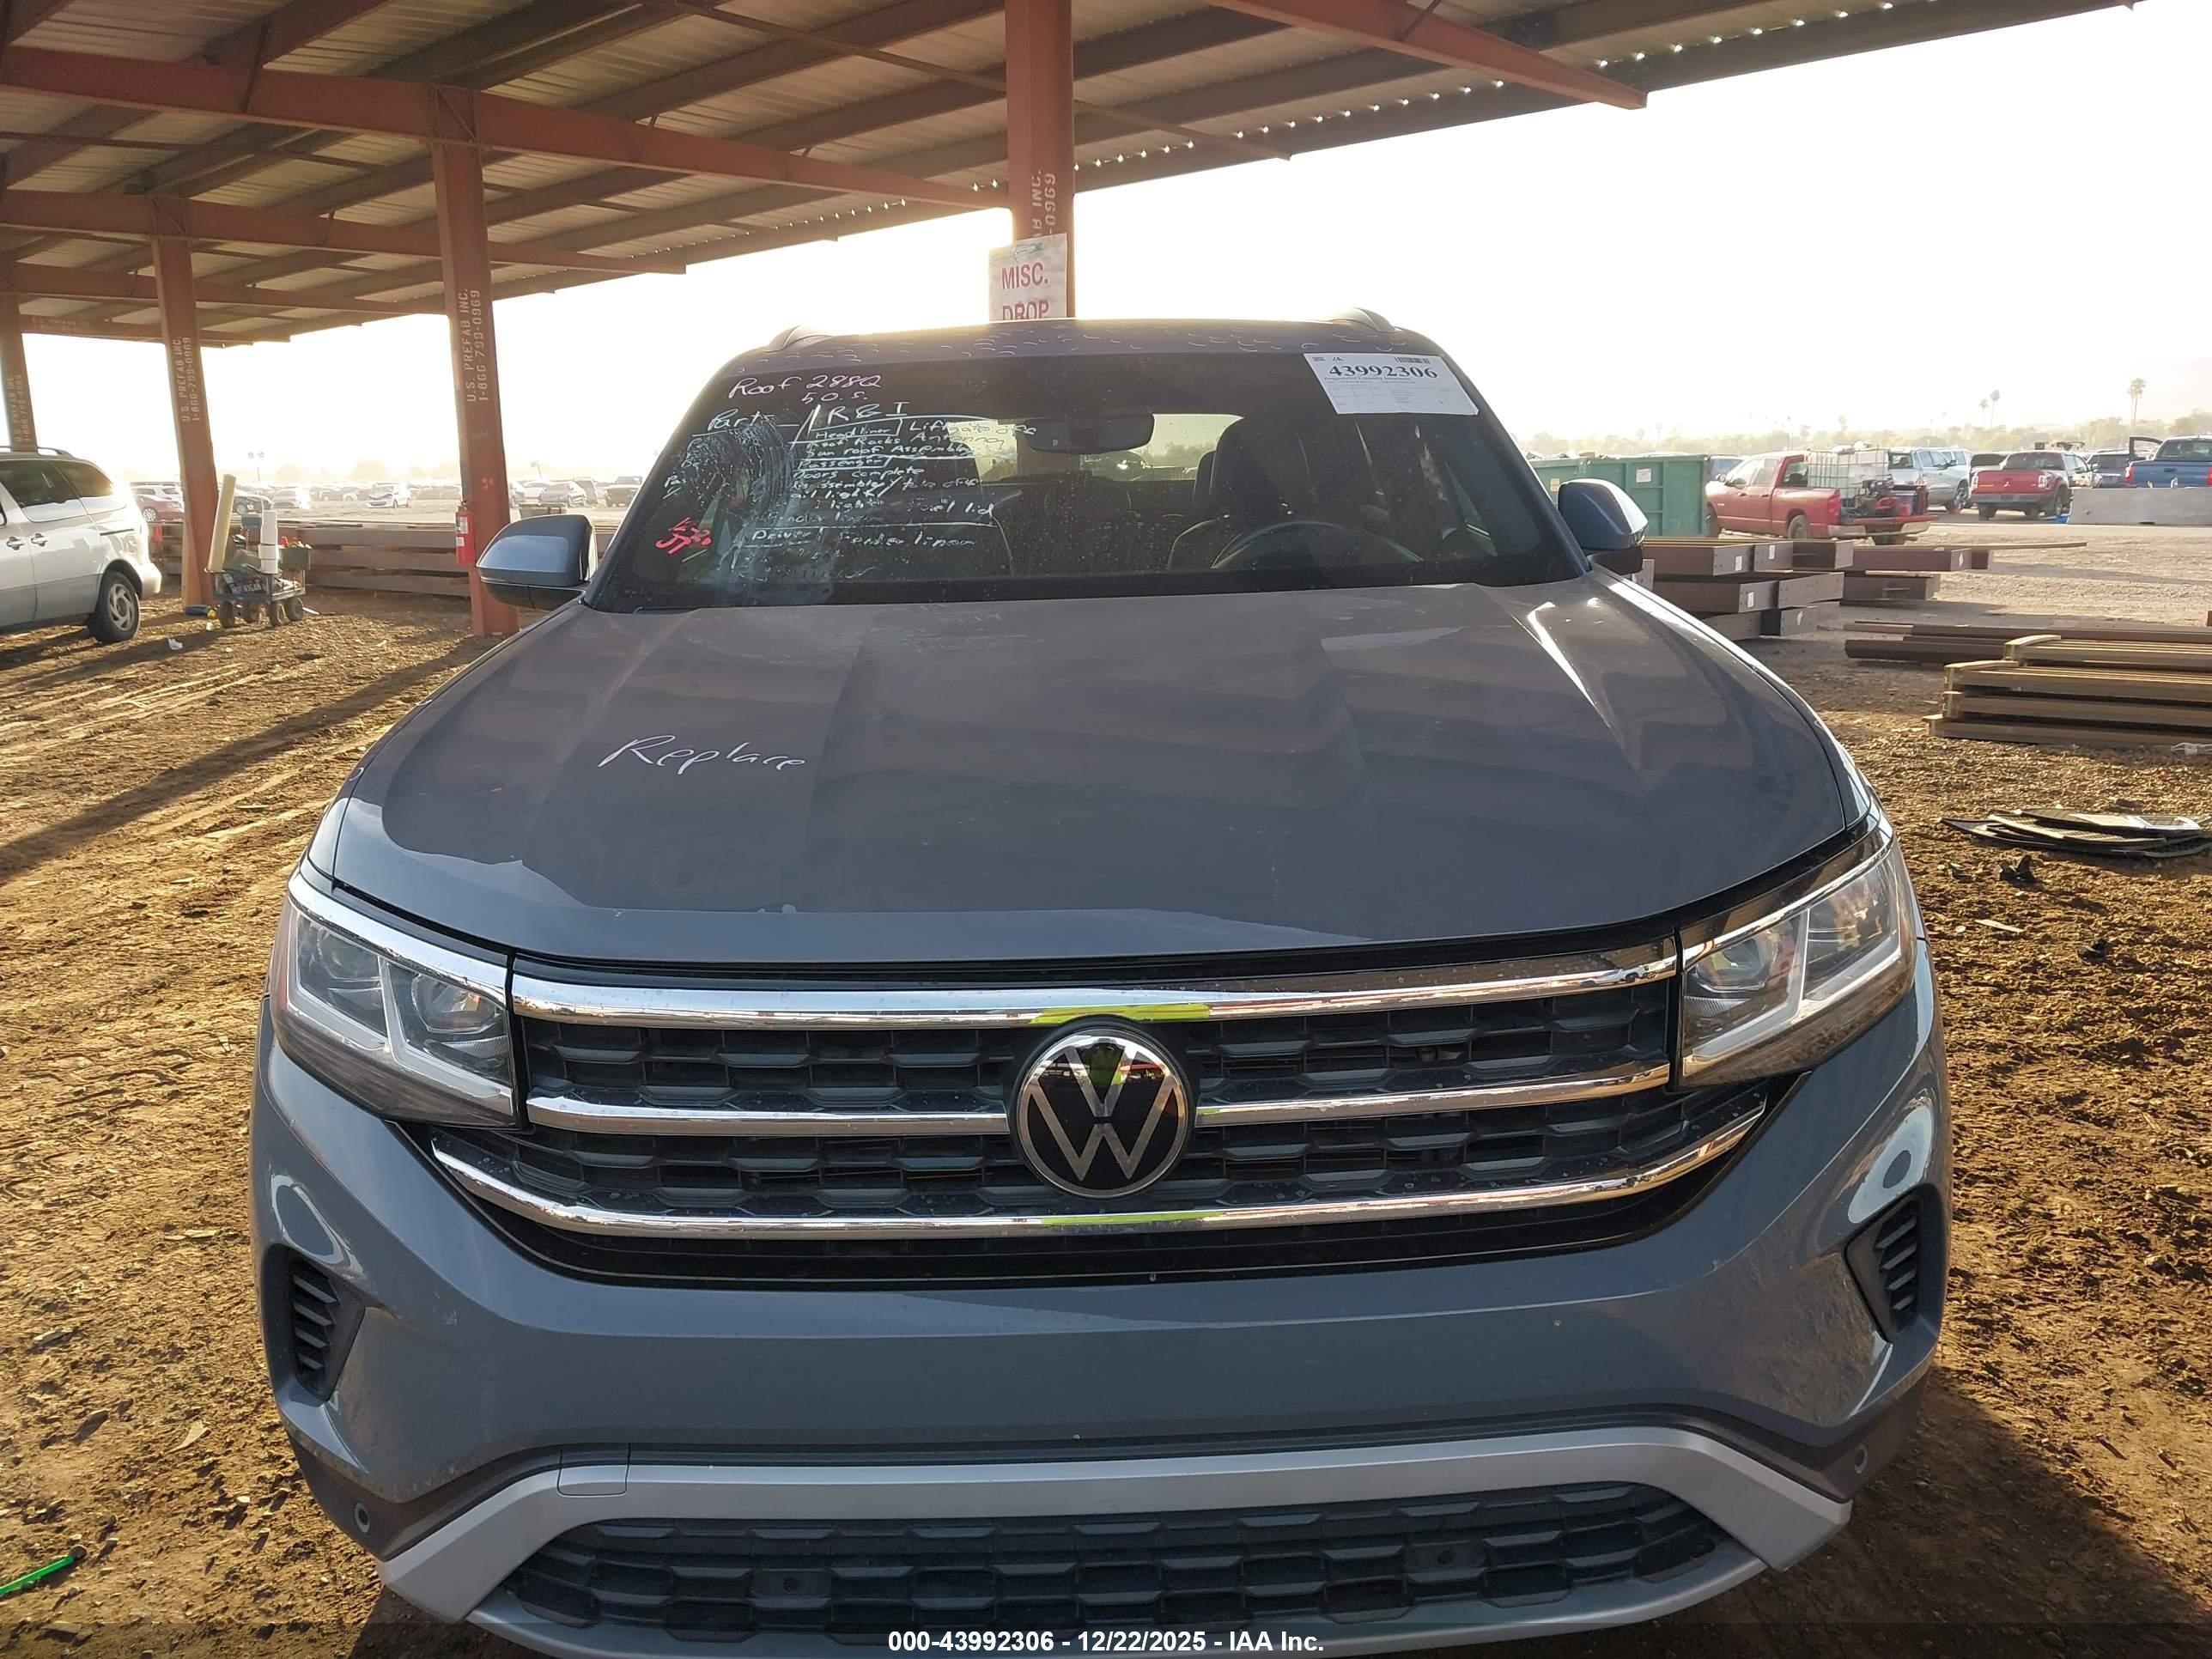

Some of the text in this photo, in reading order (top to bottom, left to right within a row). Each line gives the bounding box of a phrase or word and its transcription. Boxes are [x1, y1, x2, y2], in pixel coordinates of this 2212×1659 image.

[1031, 169, 1043, 208] INC.
[1001, 261, 1049, 290] MISC.
[1002, 299, 1049, 320] DROP
[458, 288, 477, 403] U.S. PREFAB INC.
[175, 360, 189, 398] PREFAB
[1329, 365, 1438, 379] 43992306
[728, 376, 802, 399] Roof
[854, 435, 901, 446] Racks
[793, 470, 839, 480] Doors
[797, 457, 883, 470] Passenger
[597, 734, 806, 775] Replace
